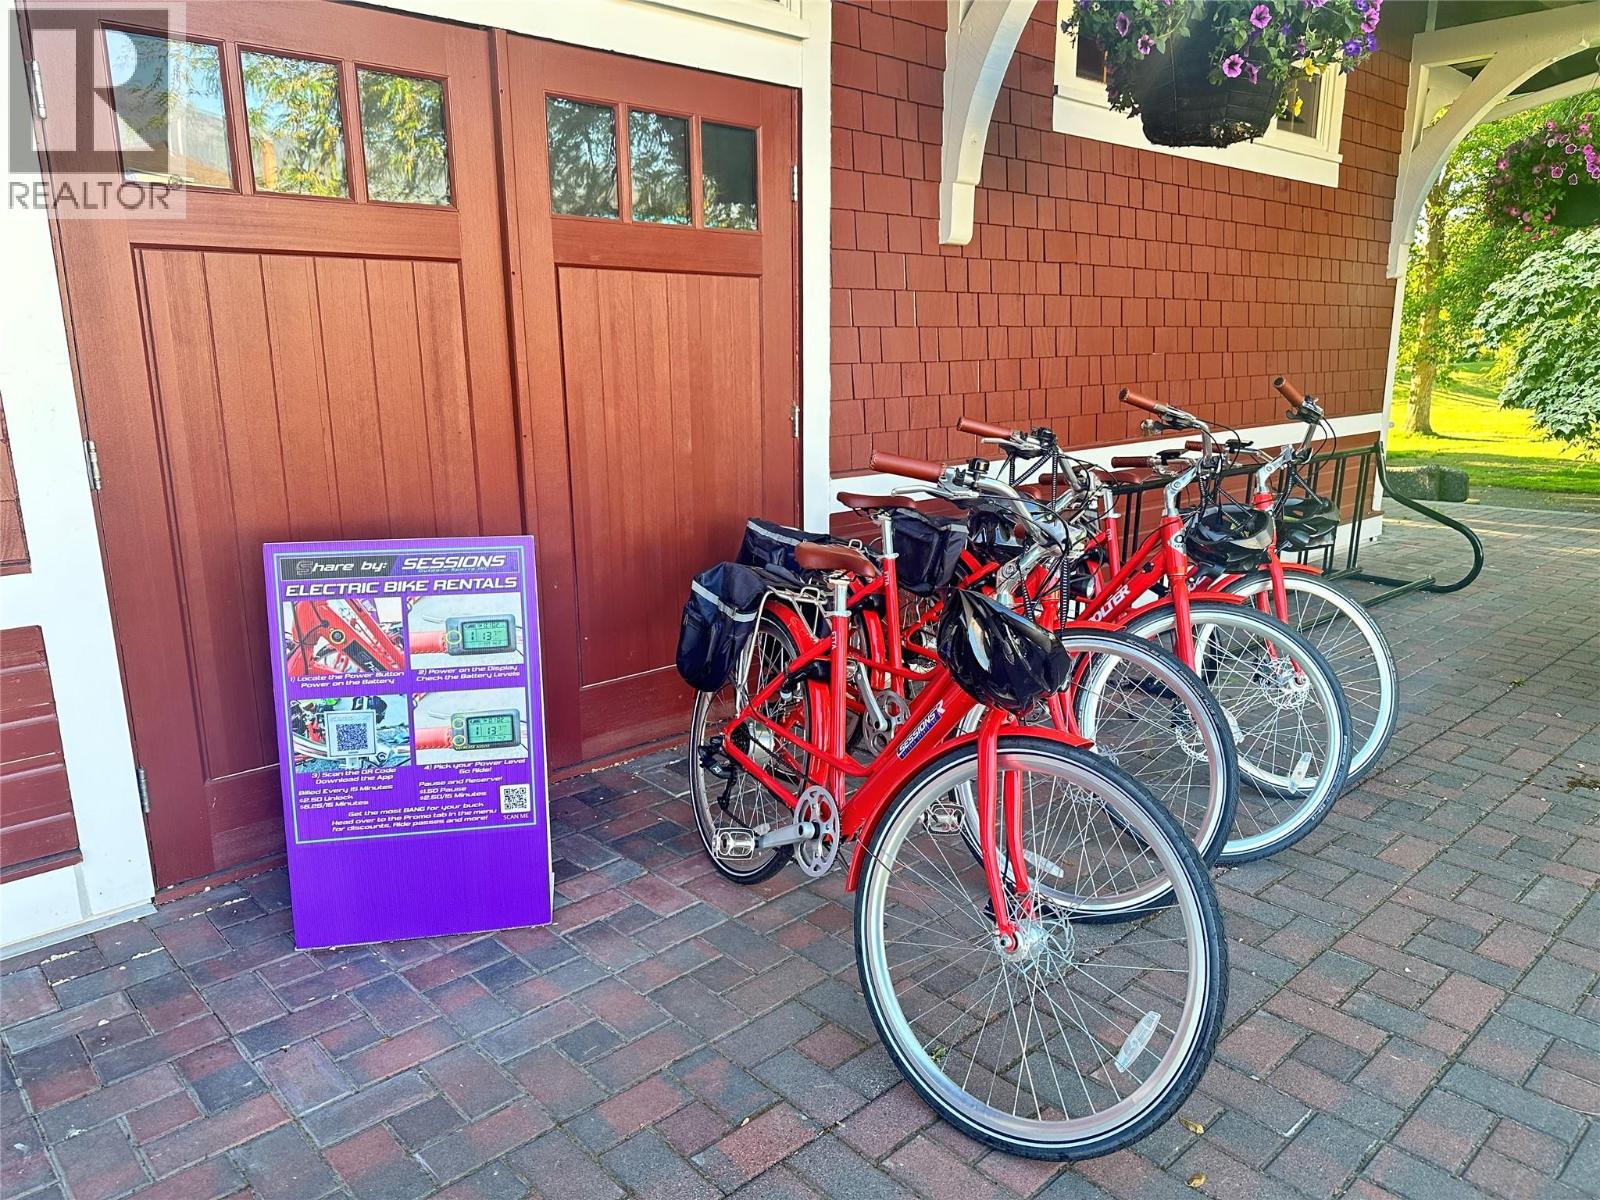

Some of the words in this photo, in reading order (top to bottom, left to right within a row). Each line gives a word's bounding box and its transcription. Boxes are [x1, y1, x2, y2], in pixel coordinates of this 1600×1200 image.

[402, 555, 507, 570] SESSIONS
[296, 560, 355, 576] Share
[361, 560, 388, 573] by:
[285, 582, 380, 597] ELECTRIC
[383, 580, 429, 593] BIKE
[433, 577, 518, 591] RENTALS
[418, 668, 427, 676] 2)
[487, 665, 518, 673] Display
[460, 672, 493, 680] Battery
[898, 713, 936, 756] SESSIONS
[453, 762, 474, 770] your
[312, 772, 321, 780] 3)
[315, 776, 360, 785] Download
[322, 787, 349, 795] Every
[359, 784, 394, 792] Minutes
[439, 786, 467, 794] Pause
[324, 794, 354, 802] Unlock
[412, 819, 445, 828] passes
